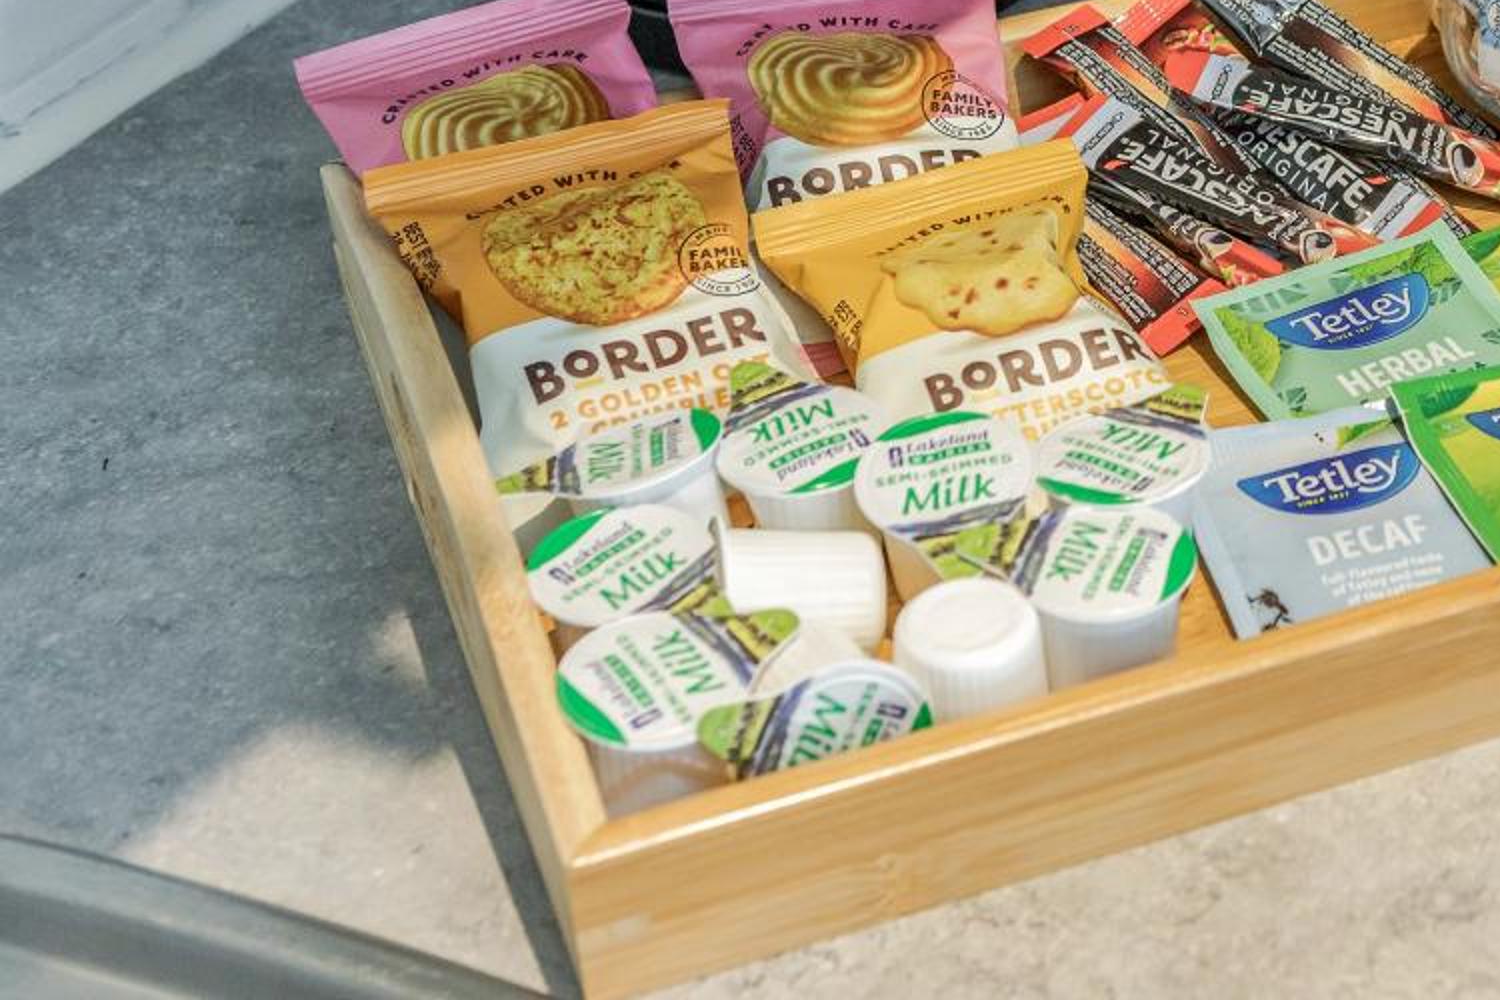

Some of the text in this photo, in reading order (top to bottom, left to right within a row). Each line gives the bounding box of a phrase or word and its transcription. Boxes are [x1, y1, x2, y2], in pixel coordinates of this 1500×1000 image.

[819, 17, 878, 29] WITH
[462, 54, 521, 80] WITH
[930, 101, 997, 120] BAKERS
[932, 89, 993, 109] FAMILY
[1263, 79, 1408, 124] ORIGINAL
[553, 168, 618, 189] WITH
[1238, 131, 1340, 216] ORIGINAL
[1290, 281, 1412, 342] Tetley
[523, 306, 767, 405] BORDER
[924, 327, 1154, 413] BORDER
[1336, 336, 1476, 398] HERBAL
[551, 410, 569, 431] 2
[577, 369, 703, 419] GOLDEN
[752, 398, 834, 444] Milk
[904, 429, 989, 453] Lakeland
[1102, 423, 1186, 460] Milk
[874, 454, 1013, 489] SEMI-SKIMMED
[902, 472, 997, 516] Milk
[1263, 449, 1400, 504] Tetley
[1047, 520, 1107, 583] Milk
[1307, 514, 1428, 566] DECAF
[599, 549, 687, 611] Milk
[652, 630, 727, 696] Milk
[786, 691, 848, 769] Mil
